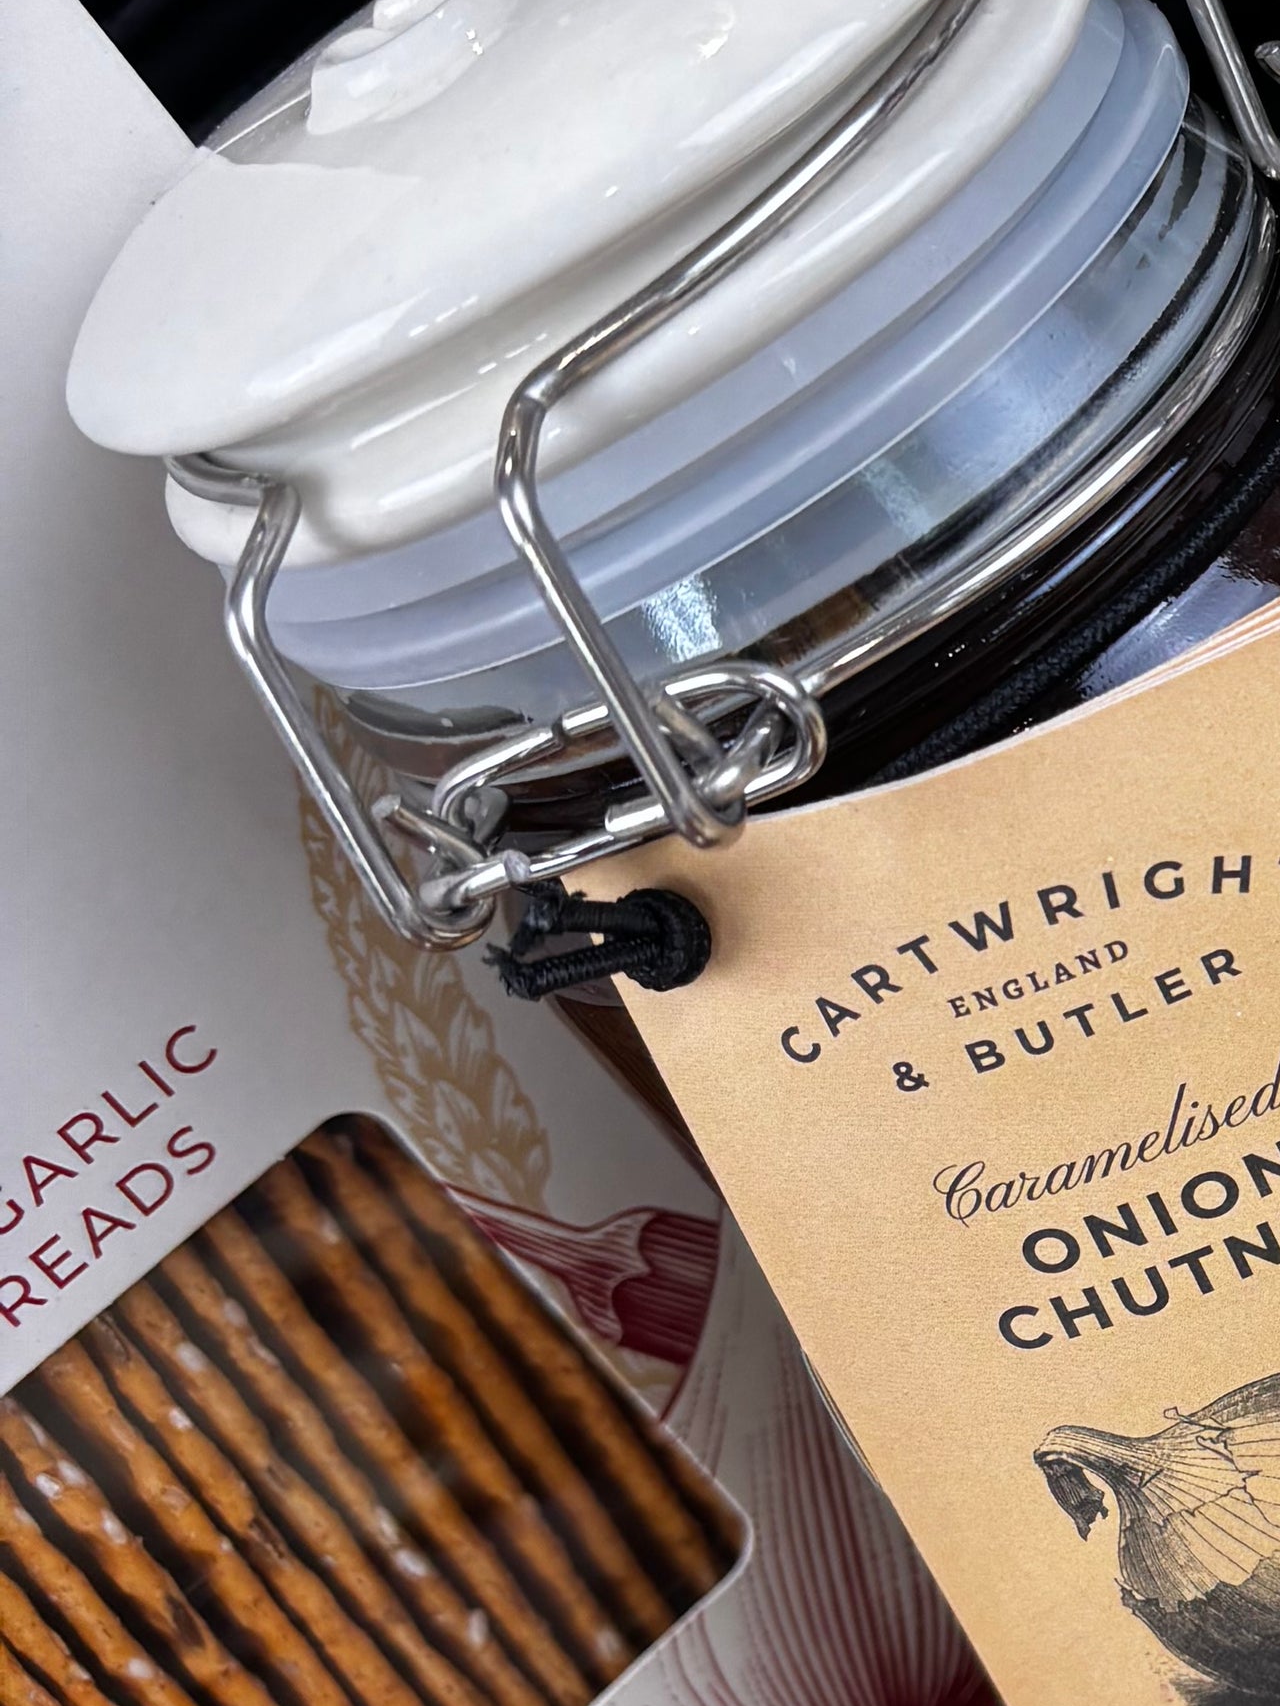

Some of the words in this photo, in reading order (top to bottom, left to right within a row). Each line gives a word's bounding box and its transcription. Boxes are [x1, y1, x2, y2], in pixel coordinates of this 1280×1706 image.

[893, 1062, 929, 1091] &
[965, 949, 1241, 1073] BUTLER
[947, 940, 1129, 1019] ENGLAND
